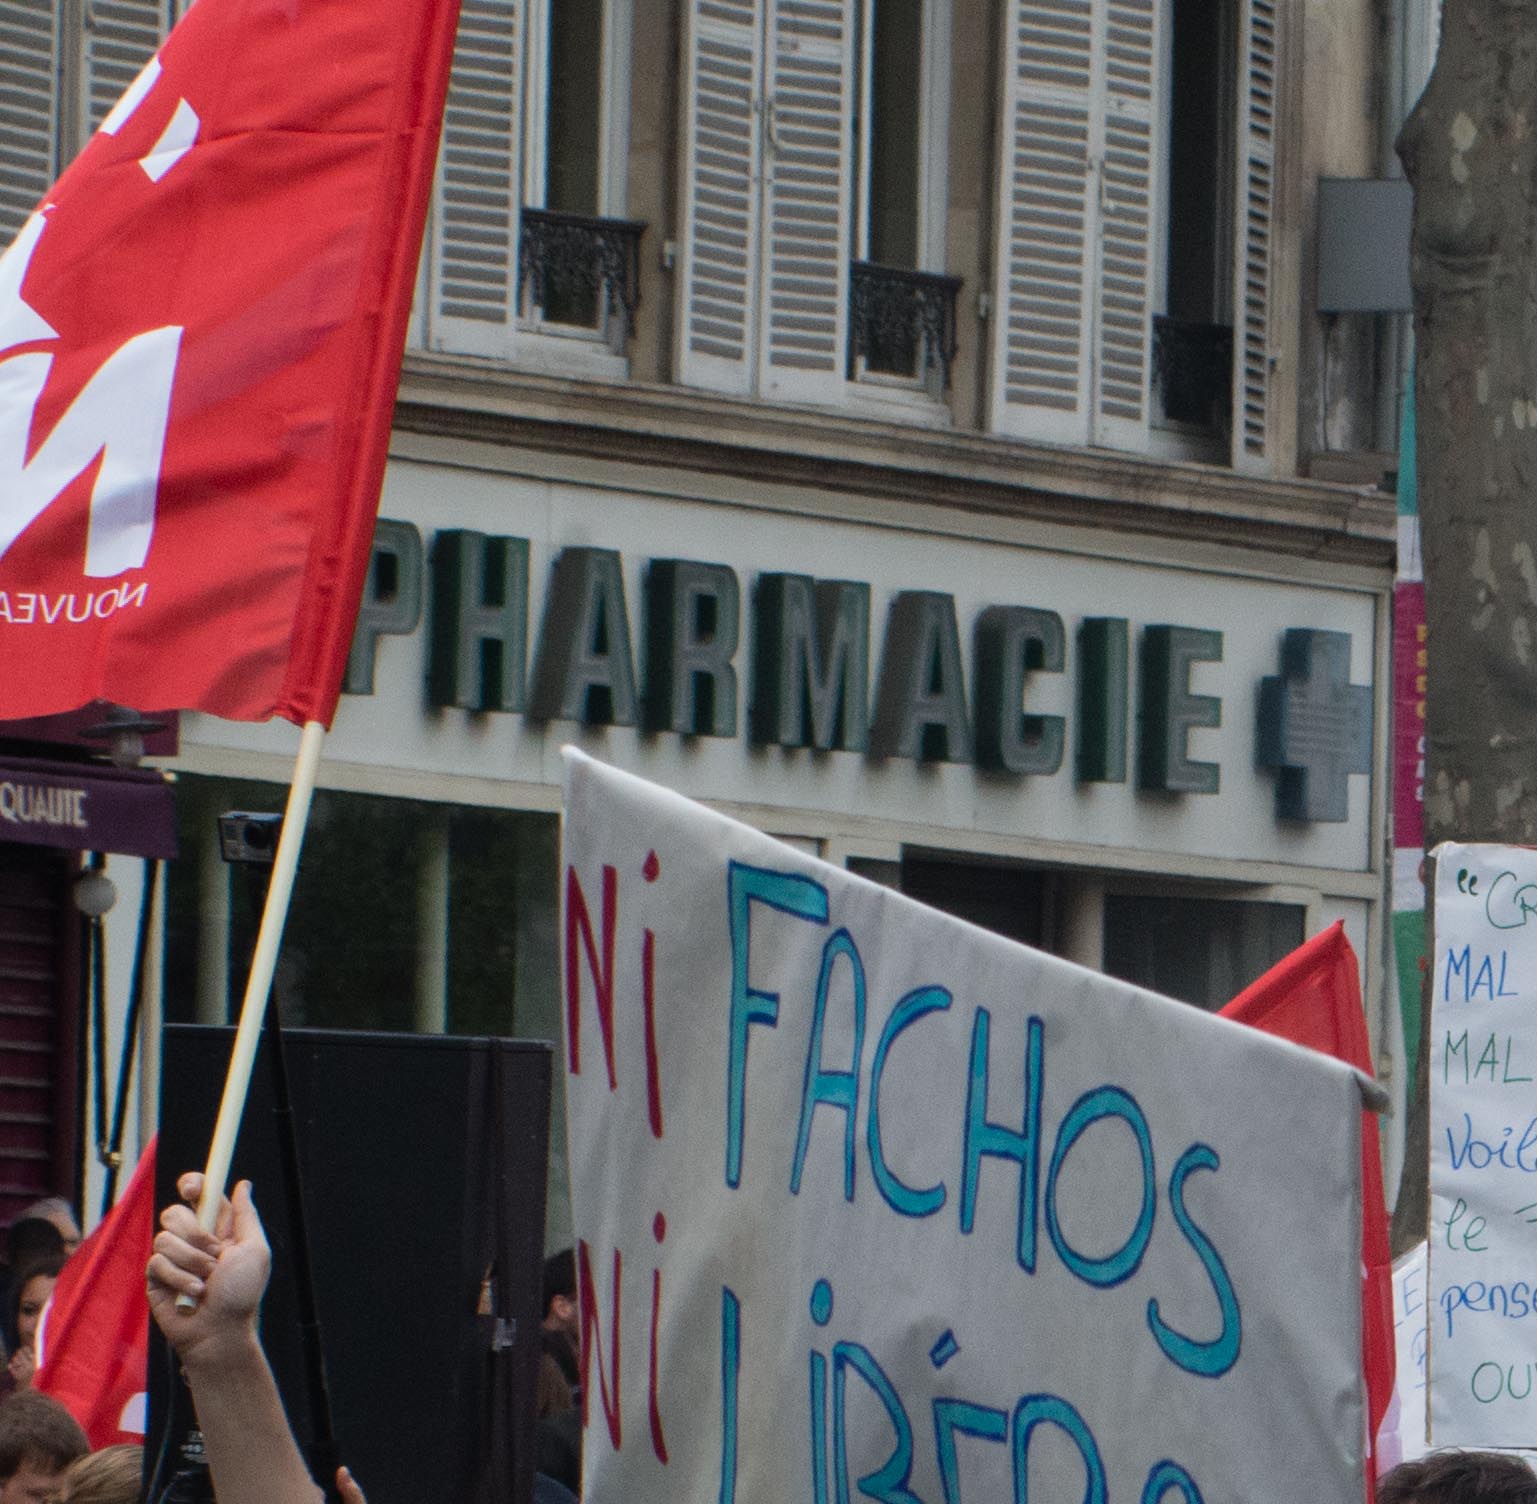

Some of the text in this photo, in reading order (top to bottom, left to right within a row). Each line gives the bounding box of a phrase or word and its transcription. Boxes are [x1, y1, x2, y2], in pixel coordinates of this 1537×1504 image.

[341, 516, 1225, 797] PHARMACIE
[1445, 944, 1520, 1002] MAL
[1445, 1030, 1533, 1084] MAL
[725, 857, 1242, 1379] FACHOS
[1445, 1197, 1490, 1253] le
